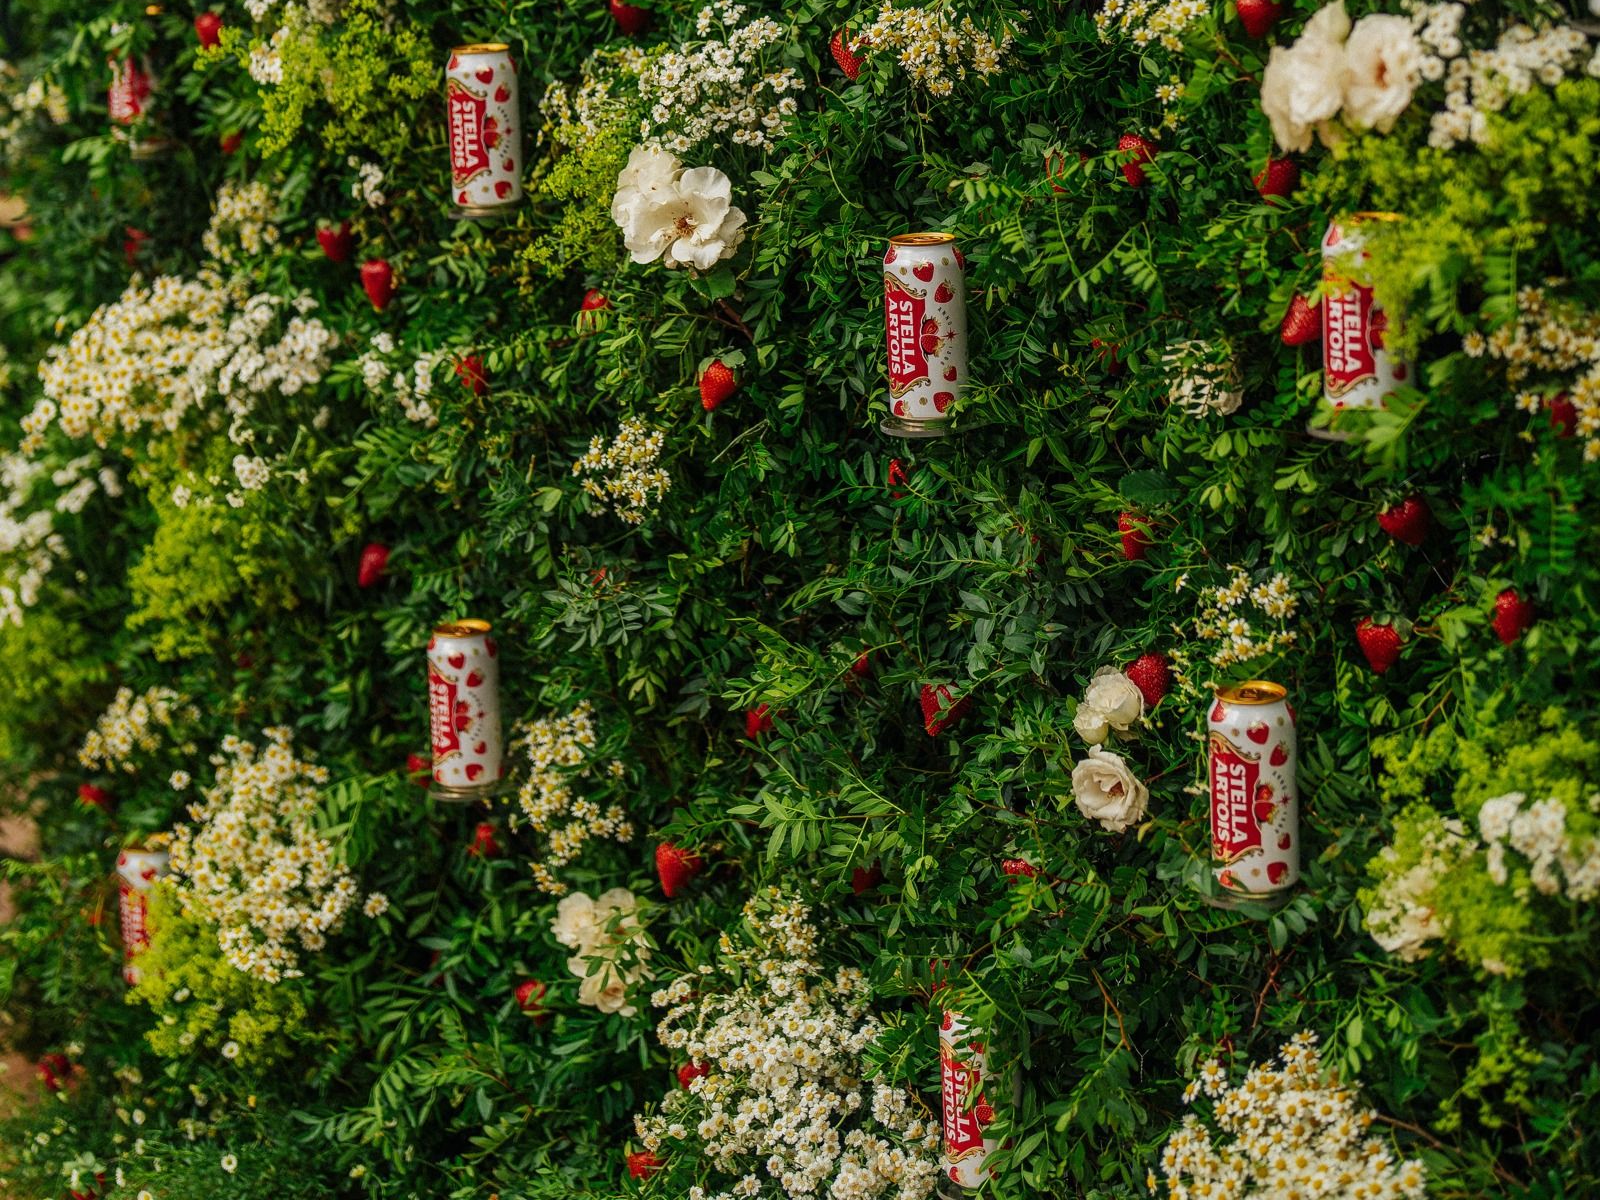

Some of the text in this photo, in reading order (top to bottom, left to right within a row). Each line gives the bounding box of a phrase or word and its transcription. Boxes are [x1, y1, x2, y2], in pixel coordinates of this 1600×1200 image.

[451, 99, 466, 169] ARTOIS
[462, 100, 479, 169] STELLA
[888, 297, 901, 375] ARTOIS
[899, 300, 916, 375] STELLA
[438, 682, 452, 749] STELLA
[1215, 757, 1231, 845] ARTOIS
[1229, 762, 1248, 845] STELLA
[943, 1062, 956, 1142] ARTOIS
